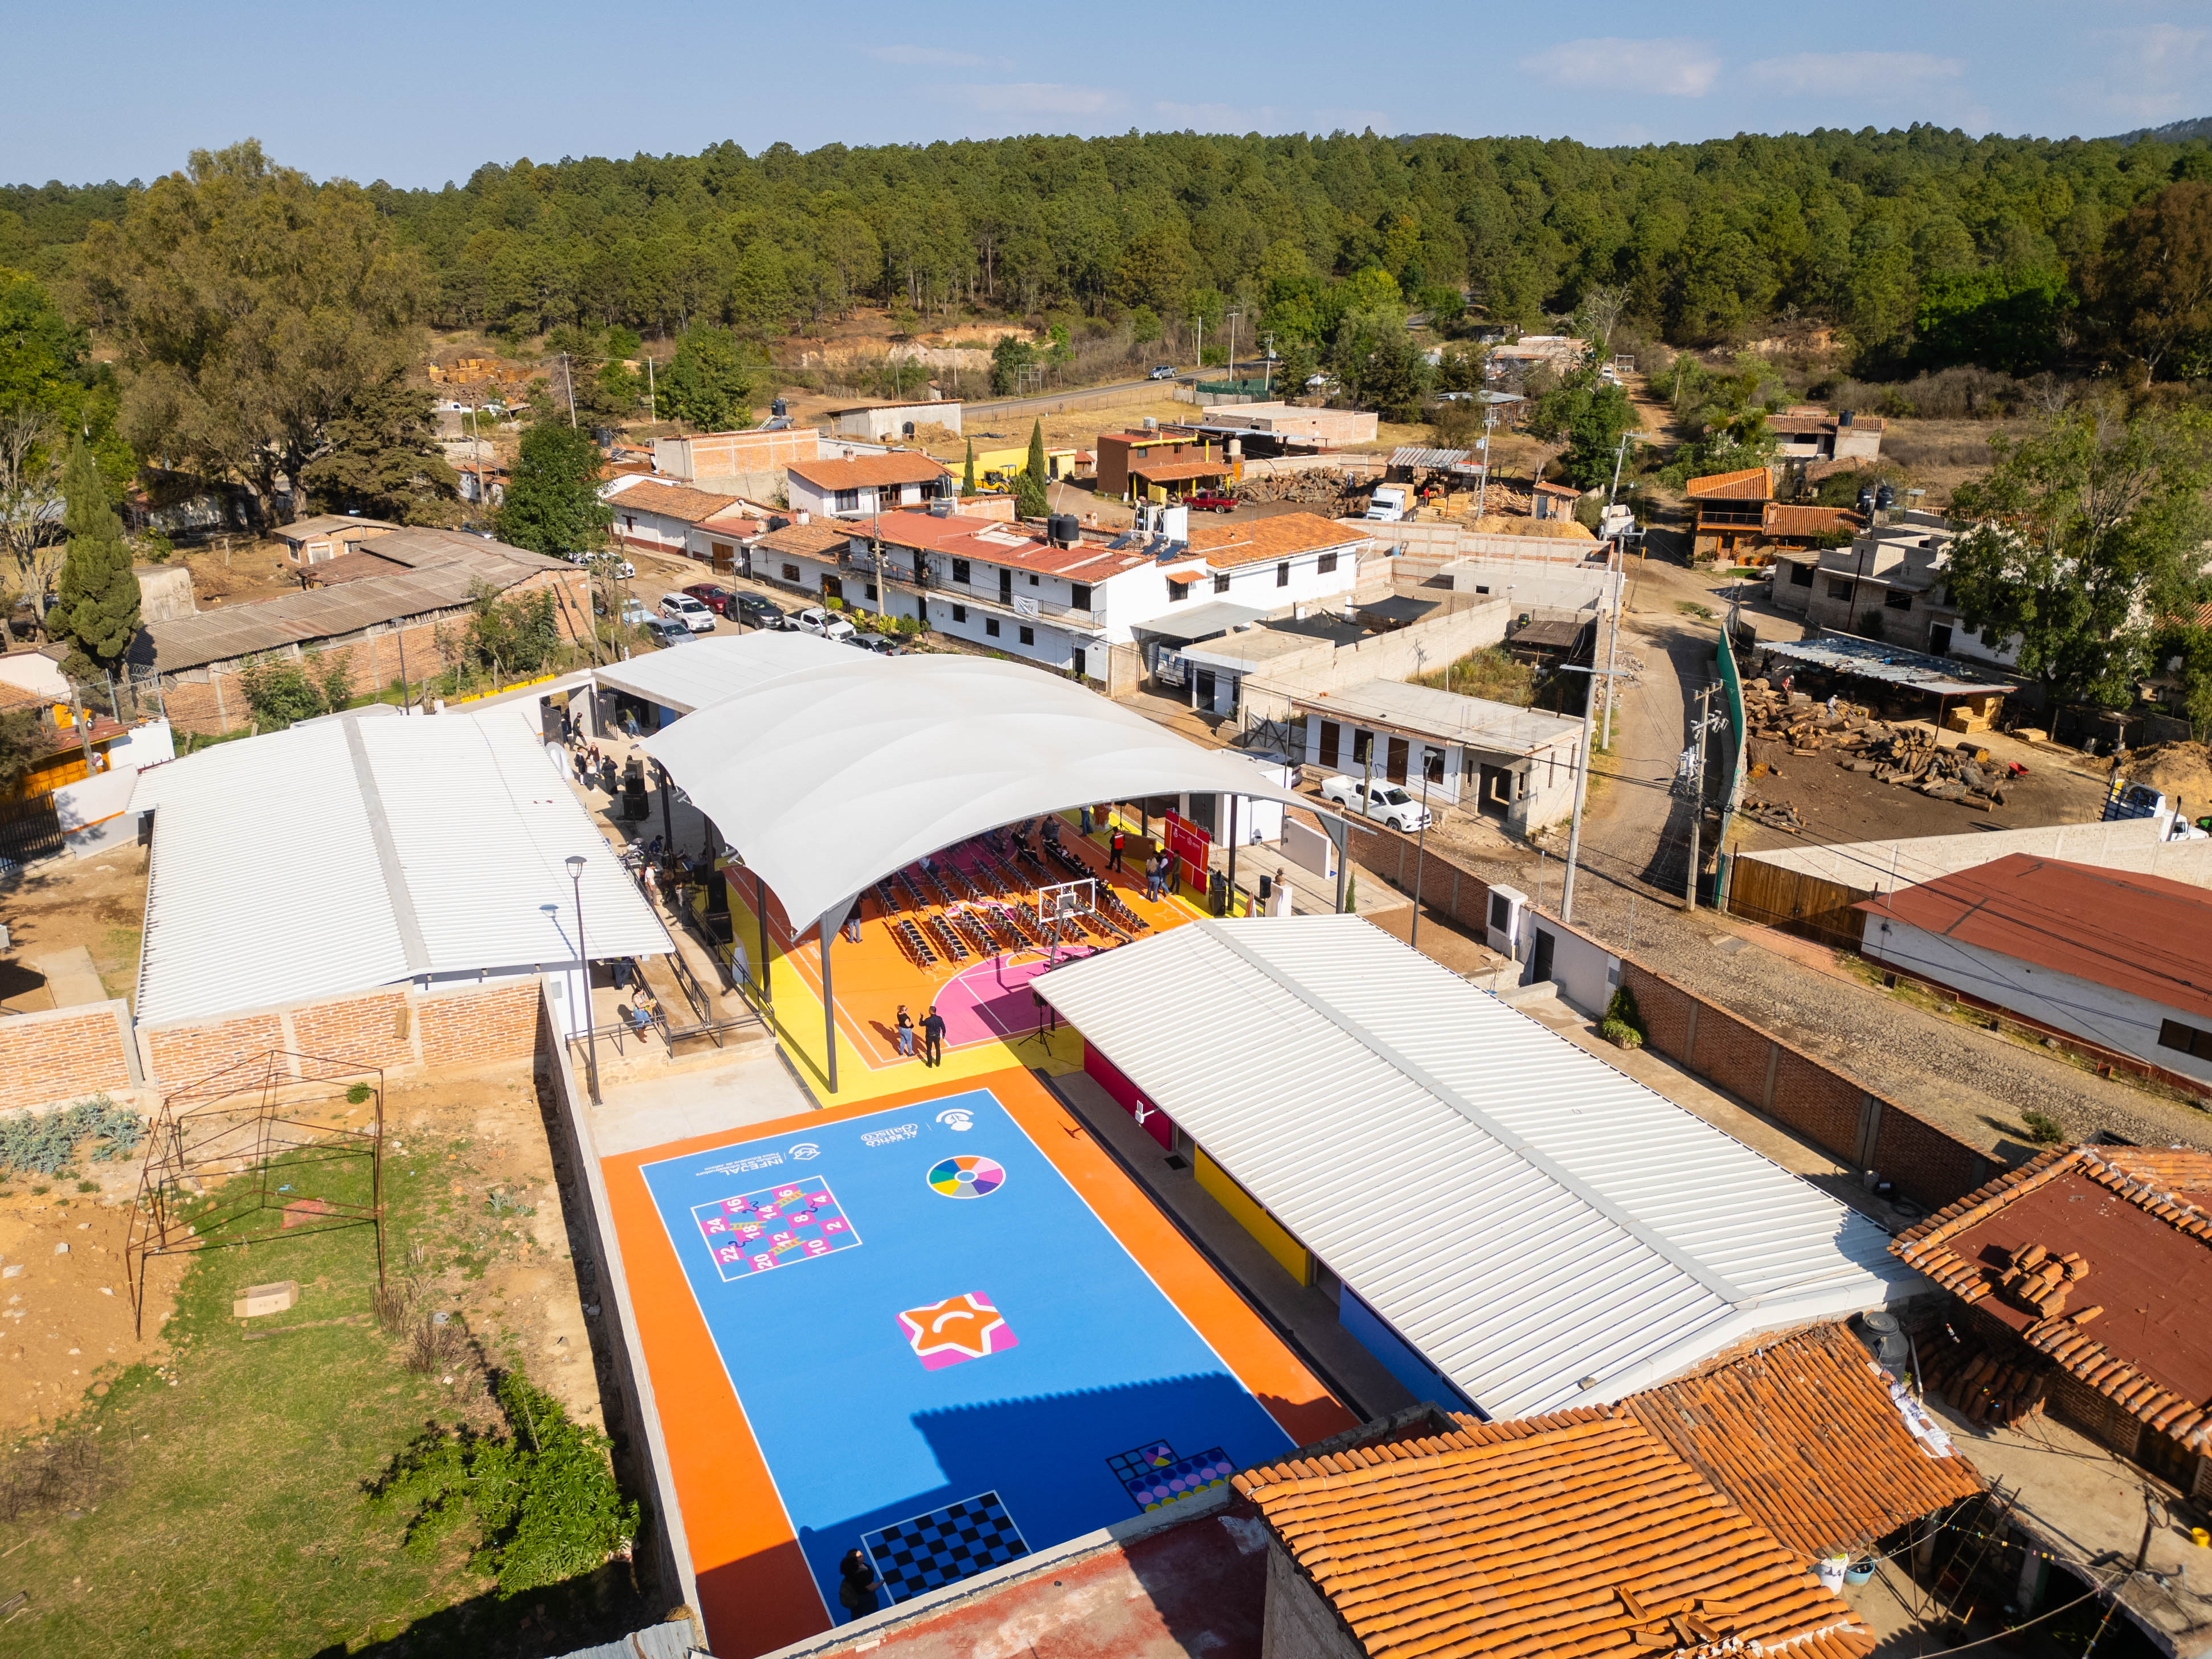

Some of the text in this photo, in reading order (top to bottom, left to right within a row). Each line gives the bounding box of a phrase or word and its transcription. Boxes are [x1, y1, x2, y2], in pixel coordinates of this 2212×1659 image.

[861, 1123, 918, 1141] Jalisco
[719, 1155, 783, 1176] INFEJAL
[779, 1188, 794, 1198] 6
[812, 1195, 827, 1203] 4
[726, 1198, 745, 1212] 16
[758, 1205, 777, 1219] 14
[706, 1217, 726, 1233] 24
[794, 1214, 809, 1223] 8
[826, 1220, 842, 1231] 2
[742, 1224, 760, 1240] 18
[772, 1231, 792, 1247] 12
[720, 1245, 739, 1262] 22
[808, 1239, 827, 1255] 10
[754, 1253, 774, 1270] 20
